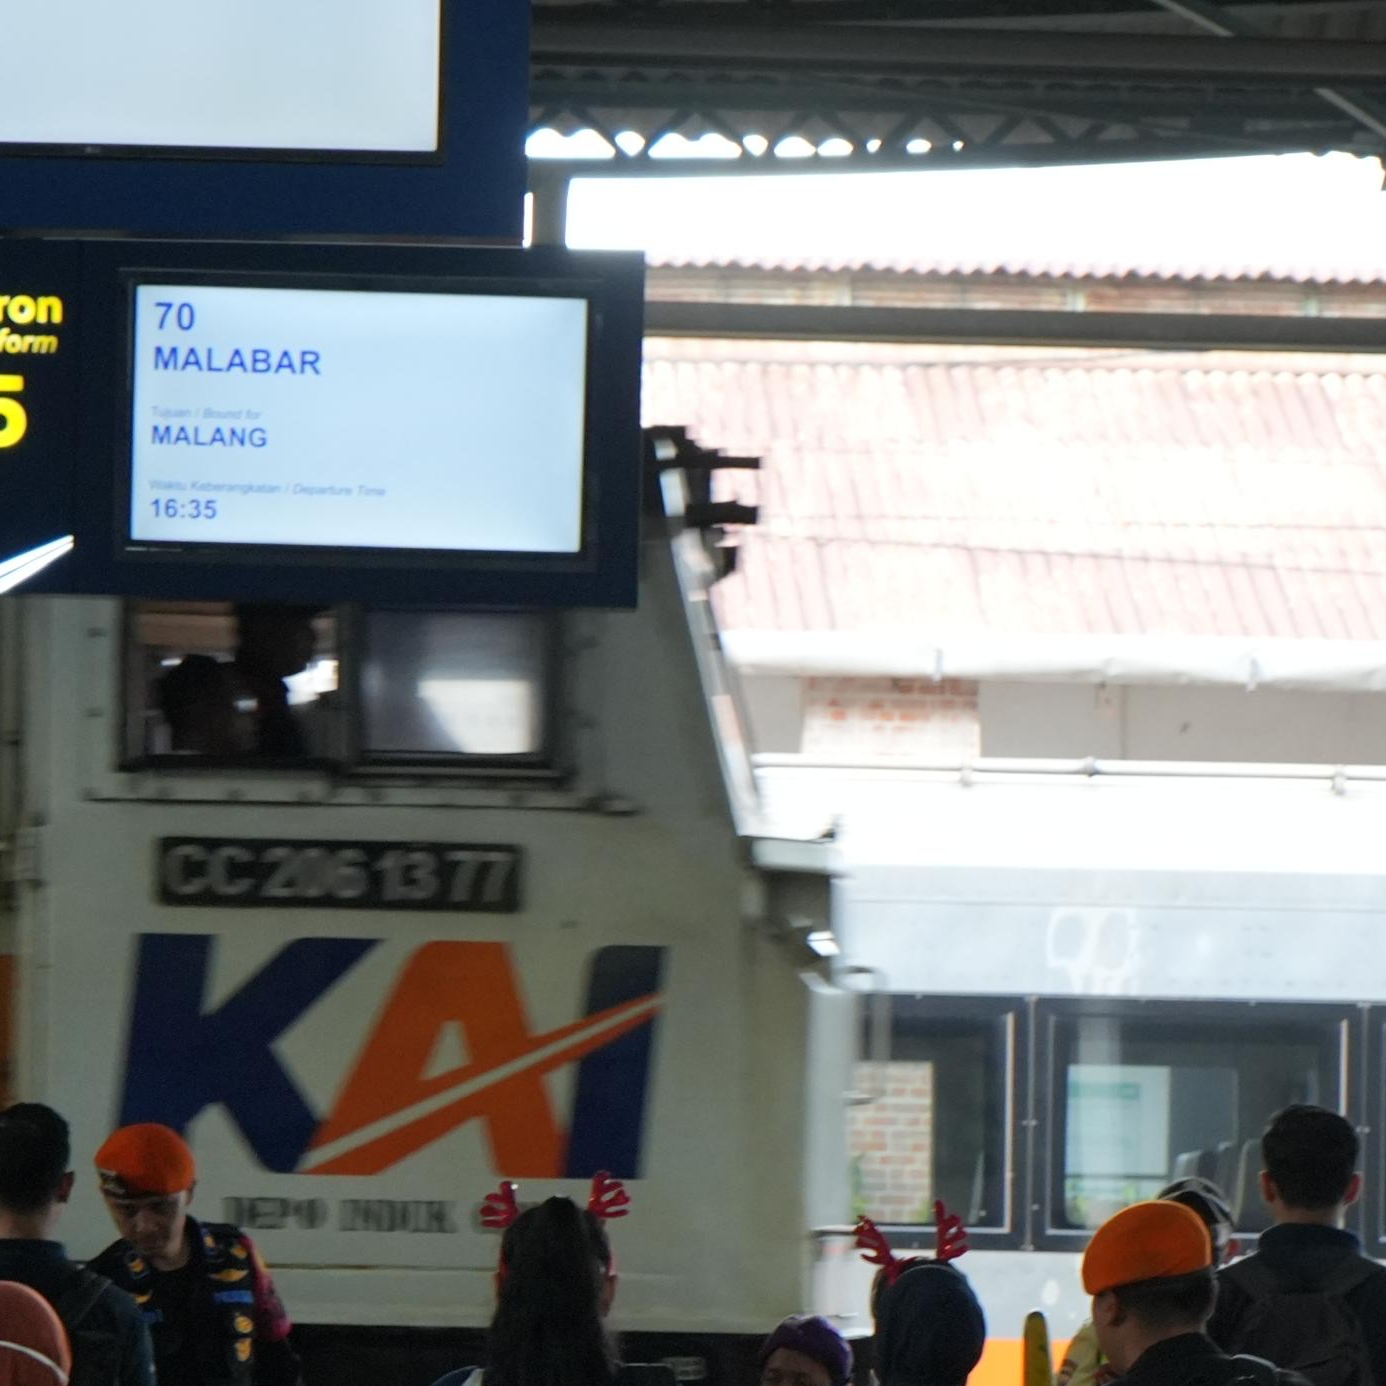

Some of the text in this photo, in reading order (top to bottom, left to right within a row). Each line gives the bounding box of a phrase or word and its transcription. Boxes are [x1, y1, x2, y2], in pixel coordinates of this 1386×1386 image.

[154, 302, 196, 331] 70
[153, 346, 322, 376] MALABAR
[151, 424, 268, 448] MALANG
[150, 498, 218, 519] 16:35
[164, 845, 255, 895] CC
[115, 932, 668, 1180] KAI
